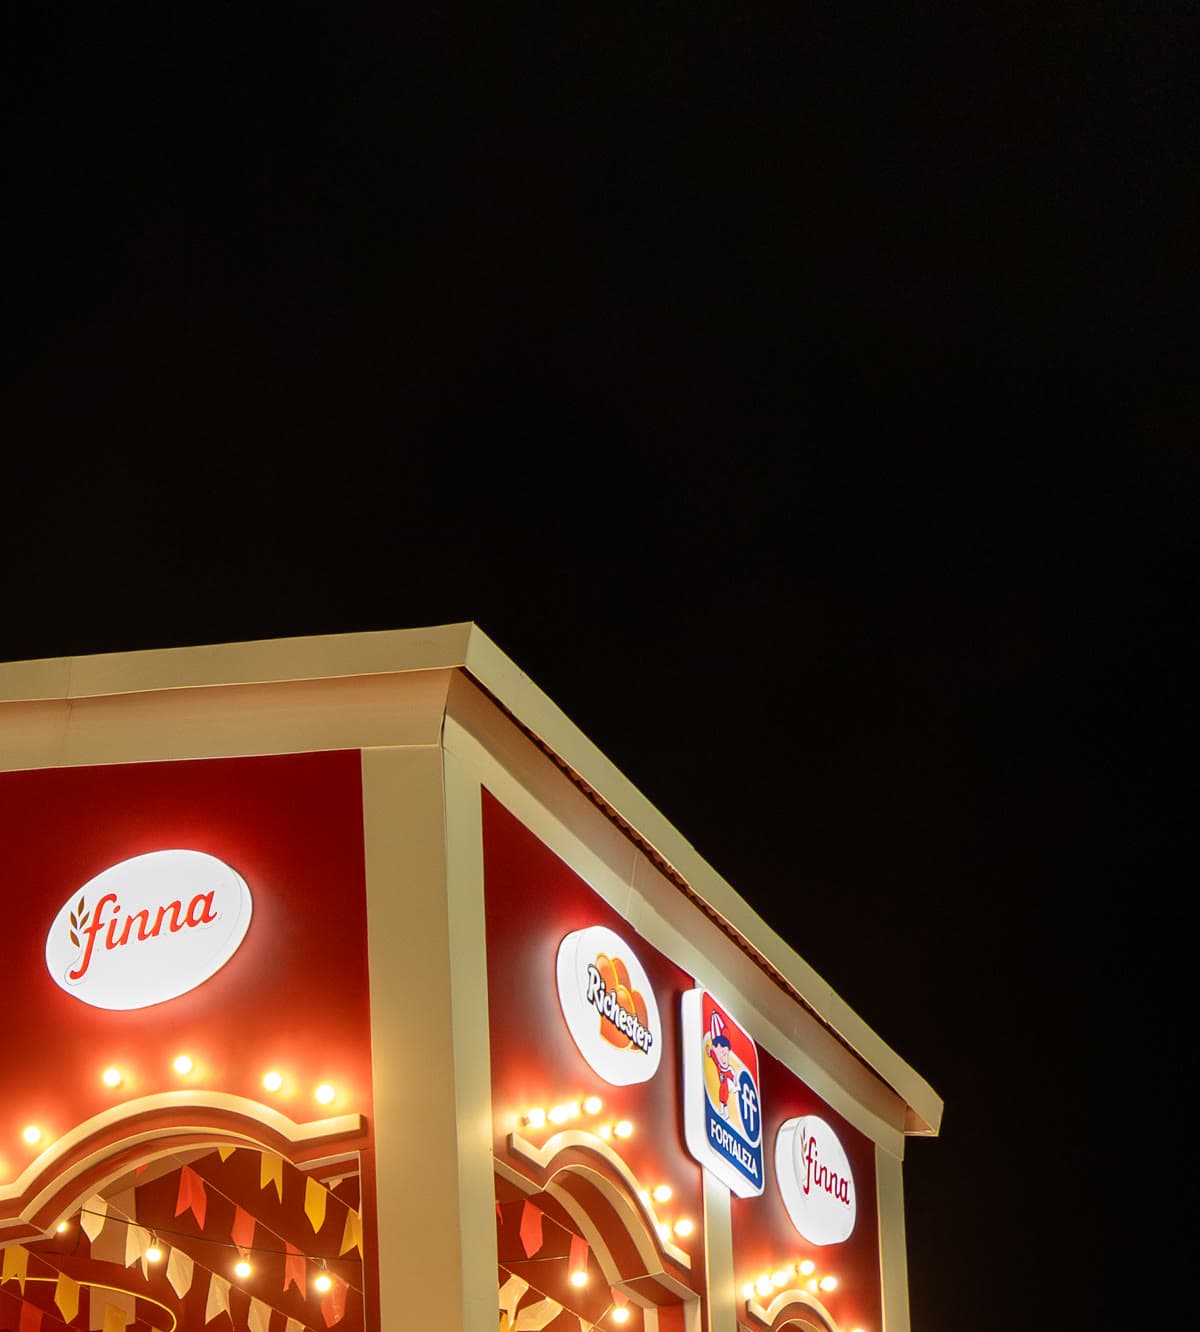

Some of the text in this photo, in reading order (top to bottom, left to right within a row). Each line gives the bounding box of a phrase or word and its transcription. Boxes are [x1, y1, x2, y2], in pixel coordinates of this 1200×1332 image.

[69, 890, 218, 981] finna
[587, 963, 654, 1055] Richester
[741, 1083, 758, 1132] ff
[710, 1118, 759, 1179] FORTALEZA
[803, 1136, 851, 1205] finna
